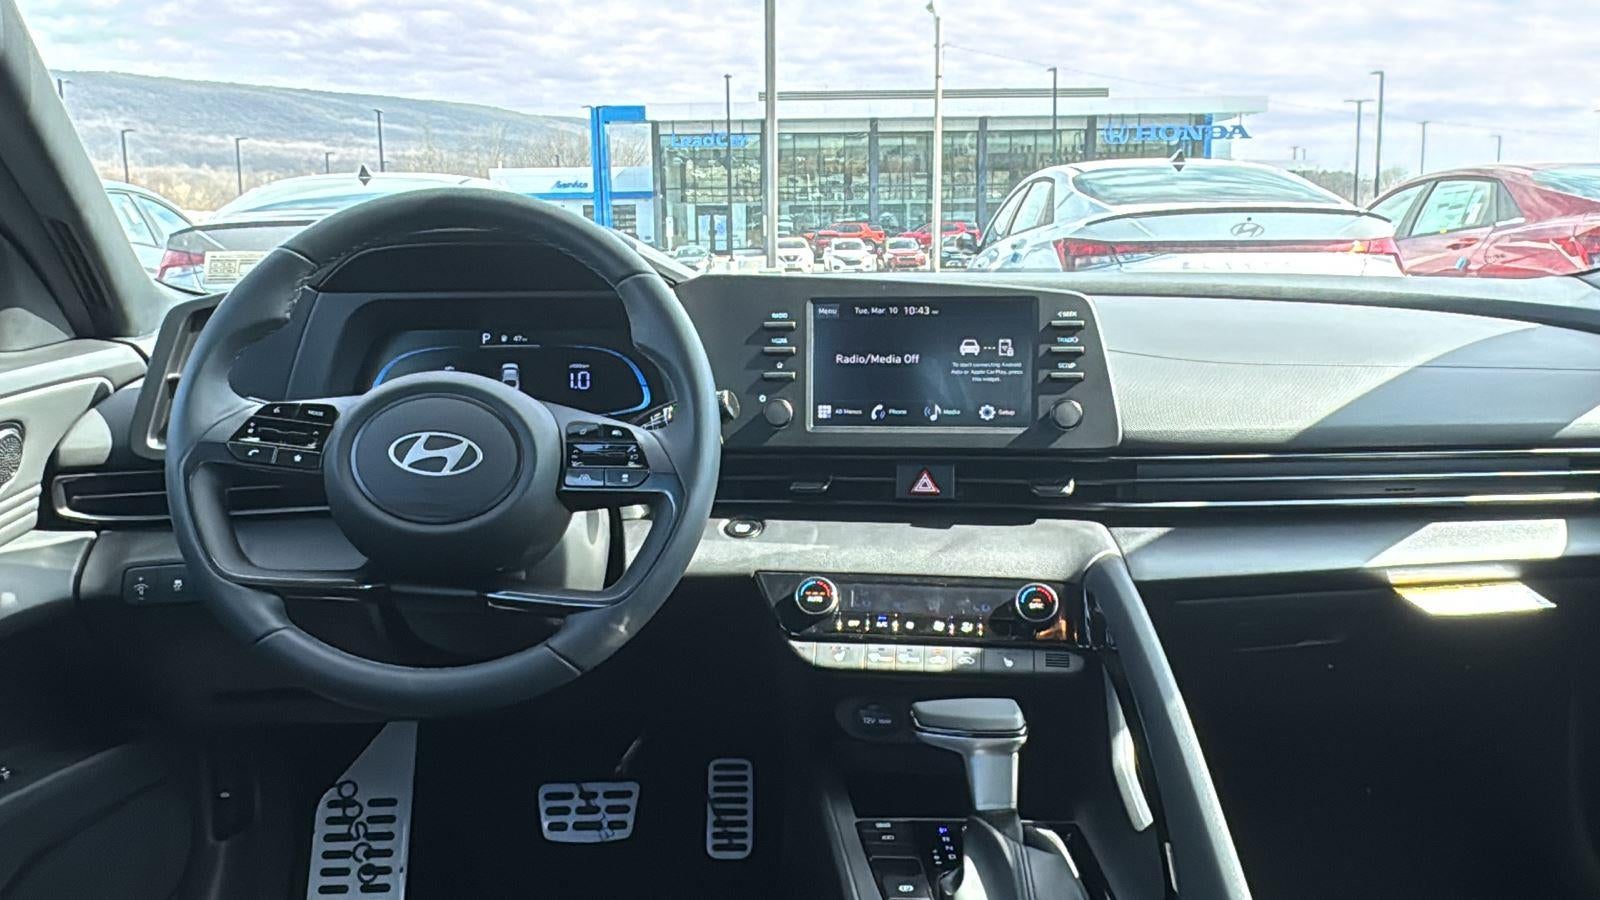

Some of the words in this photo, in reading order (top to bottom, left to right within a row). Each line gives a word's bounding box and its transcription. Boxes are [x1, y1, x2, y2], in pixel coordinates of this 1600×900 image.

[1135, 123, 1252, 143] HONDA
[818, 307, 838, 315] Menu
[870, 306, 886, 314] Mar
[889, 306, 899, 314] 10
[903, 305, 930, 315] 10:43
[482, 332, 491, 344] P
[835, 353, 902, 365] Radio/Media
[903, 353, 920, 364] Off
[569, 371, 591, 390] 1.0
